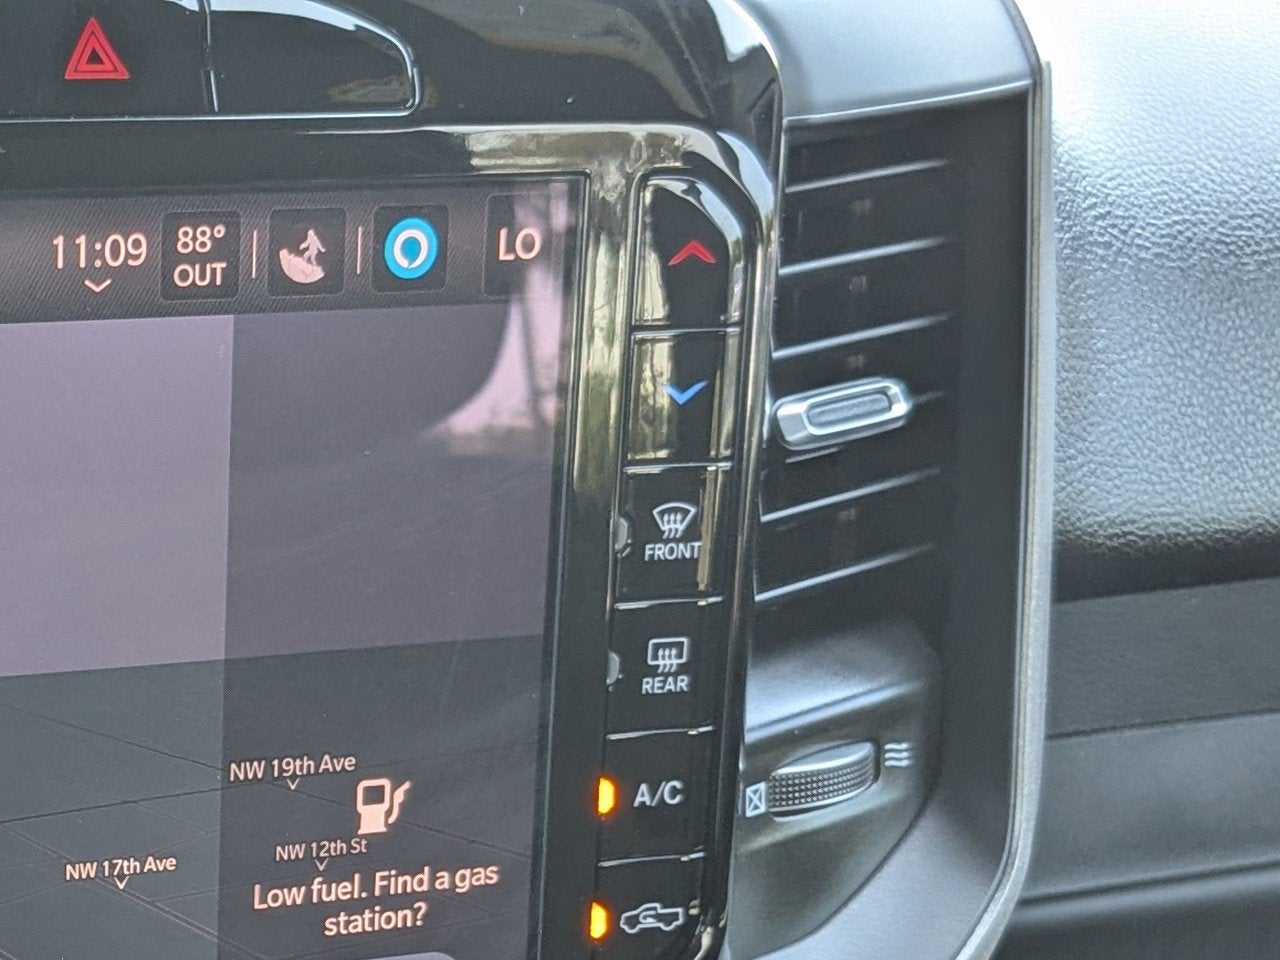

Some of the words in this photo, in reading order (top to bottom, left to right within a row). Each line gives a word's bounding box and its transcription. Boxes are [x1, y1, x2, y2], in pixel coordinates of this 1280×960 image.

[52, 232, 148, 270] 11:09
[176, 224, 226, 254] 88°
[498, 227, 542, 262] LO
[173, 262, 227, 287] OUT
[644, 541, 703, 562] FRONT
[641, 675, 690, 695] REAR
[229, 760, 266, 782] NW
[271, 755, 315, 778] 19th
[318, 753, 356, 774] Ave
[633, 780, 684, 808] A/C
[275, 842, 306, 862] NW
[309, 838, 348, 858] 12th
[349, 837, 368, 854] St
[65, 861, 98, 881] NW
[101, 857, 141, 878] 17th
[143, 855, 178, 874] Ave
[253, 882, 306, 910] Low
[310, 873, 367, 904] fuel.
[374, 865, 429, 897] Find
[434, 871, 451, 891] a
[454, 864, 499, 894] gas
[323, 902, 427, 937] station?
